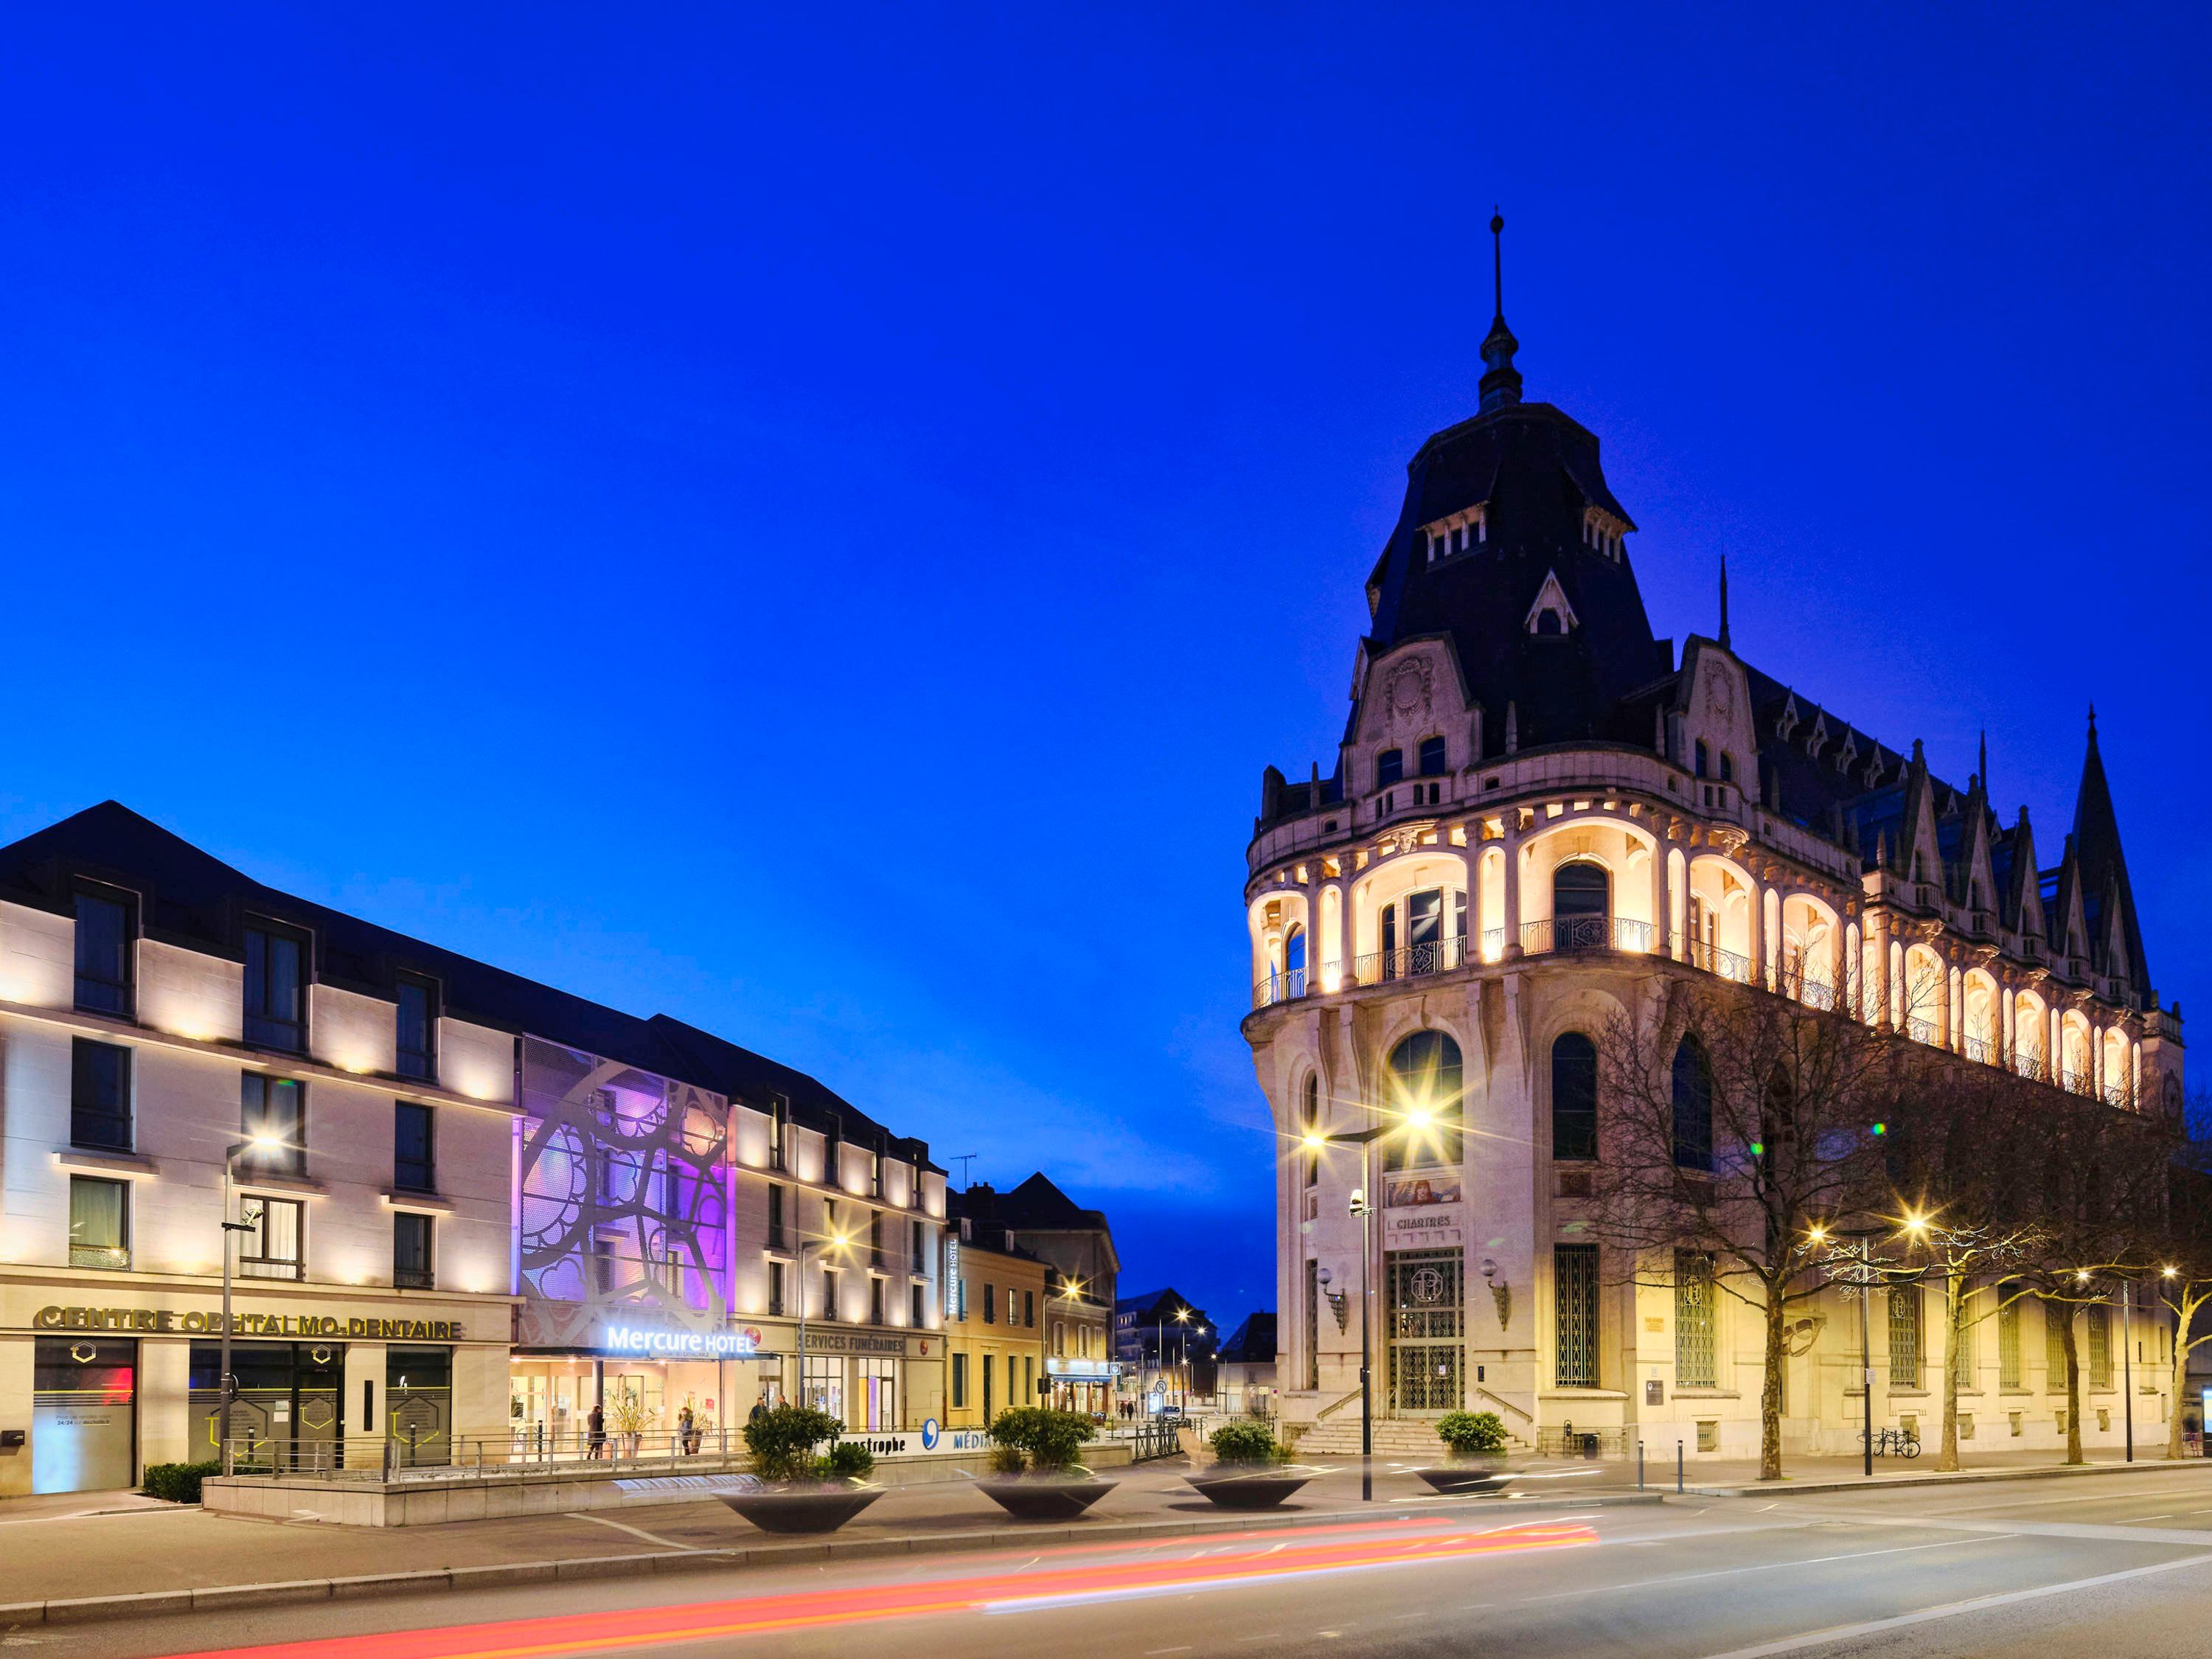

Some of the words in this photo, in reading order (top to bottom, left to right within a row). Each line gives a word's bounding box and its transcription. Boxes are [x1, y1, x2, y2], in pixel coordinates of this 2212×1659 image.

[1397, 1215, 1450, 1230] CHARTRES
[38, 1305, 174, 1330] CENTRE
[608, 1326, 701, 1351] Mercure
[706, 1335, 755, 1352] HOTEL
[849, 1335, 903, 1352] FUNÉRAIRES
